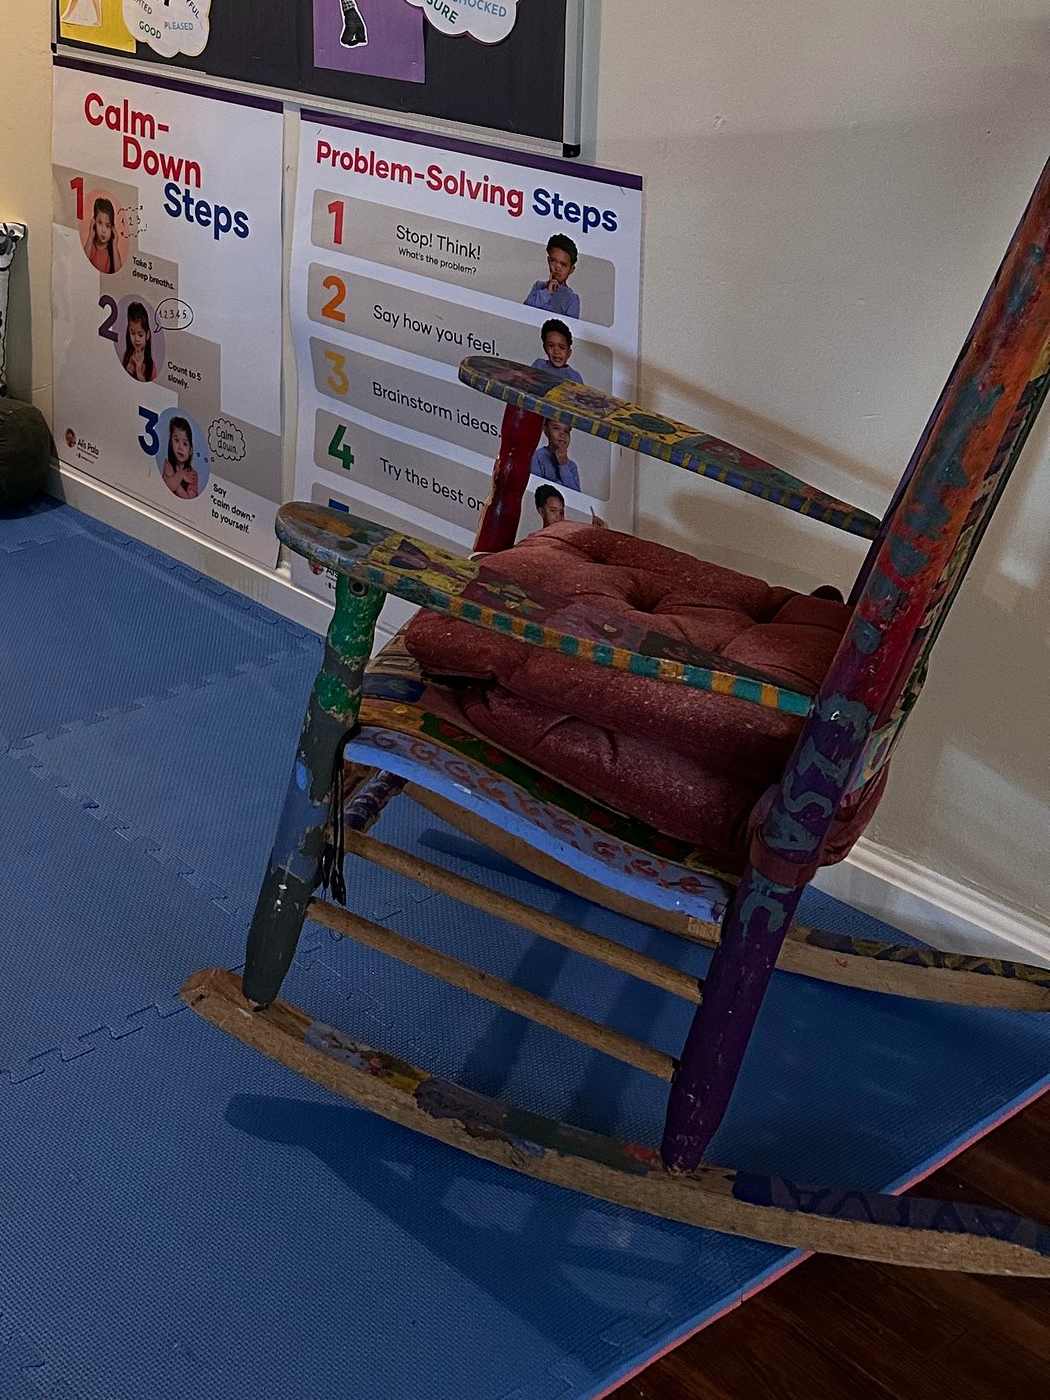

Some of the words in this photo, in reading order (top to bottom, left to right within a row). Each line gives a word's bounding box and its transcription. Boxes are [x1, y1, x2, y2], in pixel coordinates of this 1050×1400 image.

[139, 21, 161, 39] GOOD
[164, 21, 193, 30] PLEASED
[84, 93, 169, 140] Calm-
[123, 135, 201, 188] Down
[70, 177, 84, 220] 1
[316, 139, 524, 218] Problem-Solving
[532, 188, 618, 233] Steps
[163, 182, 249, 241] Steps
[327, 200, 344, 245] 1
[133, 256, 147, 269] Take
[148, 262, 153, 270] 3
[396, 225, 432, 249] Stop!
[437, 234, 481, 260] Think!
[398, 246, 424, 261] What's
[426, 255, 438, 265] the
[440, 260, 477, 275] problem?
[132, 270, 148, 282] deep
[149, 274, 175, 290] breaths.
[321, 275, 346, 322] 2
[98, 294, 118, 343] 2
[373, 305, 400, 328] Say
[404, 313, 432, 336] how
[436, 325, 463, 346] you
[467, 331, 500, 357] feel.
[167, 361, 188, 376] Count
[189, 369, 196, 378] to
[197, 372, 202, 381] 5
[168, 374, 189, 390] slowly.
[324, 350, 350, 396] 3
[138, 406, 160, 456] 3
[372, 381, 453, 421] Brainstorm
[456, 408, 502, 439] ideas.
[216, 426, 234, 441] Calm
[328, 424, 354, 470] 4
[213, 483, 227, 498] Say
[380, 457, 402, 481] Try
[405, 468, 428, 489] the
[432, 478, 463, 504] best
[210, 495, 230, 511] "calm
[211, 509, 219, 519] to
[220, 514, 250, 534] yourself.
